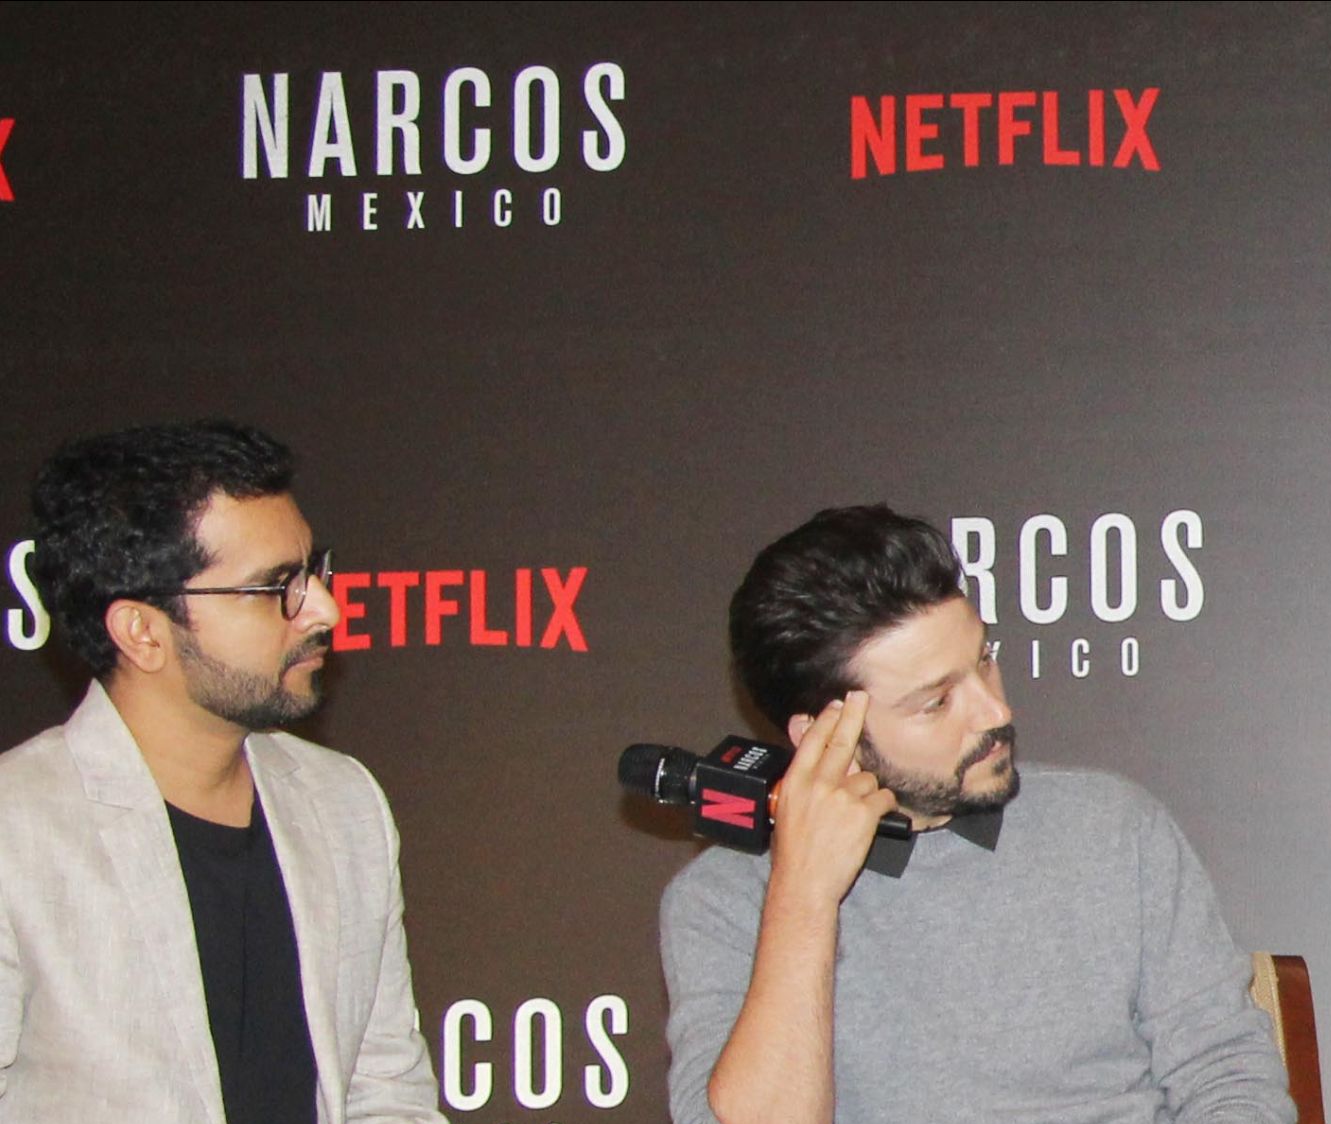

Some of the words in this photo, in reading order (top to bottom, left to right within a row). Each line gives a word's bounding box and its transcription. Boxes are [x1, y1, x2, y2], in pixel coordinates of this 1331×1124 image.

[244, 63, 625, 178] NARCOS
[850, 88, 1160, 180] NETFLIX
[308, 188, 560, 231] MEXICO
